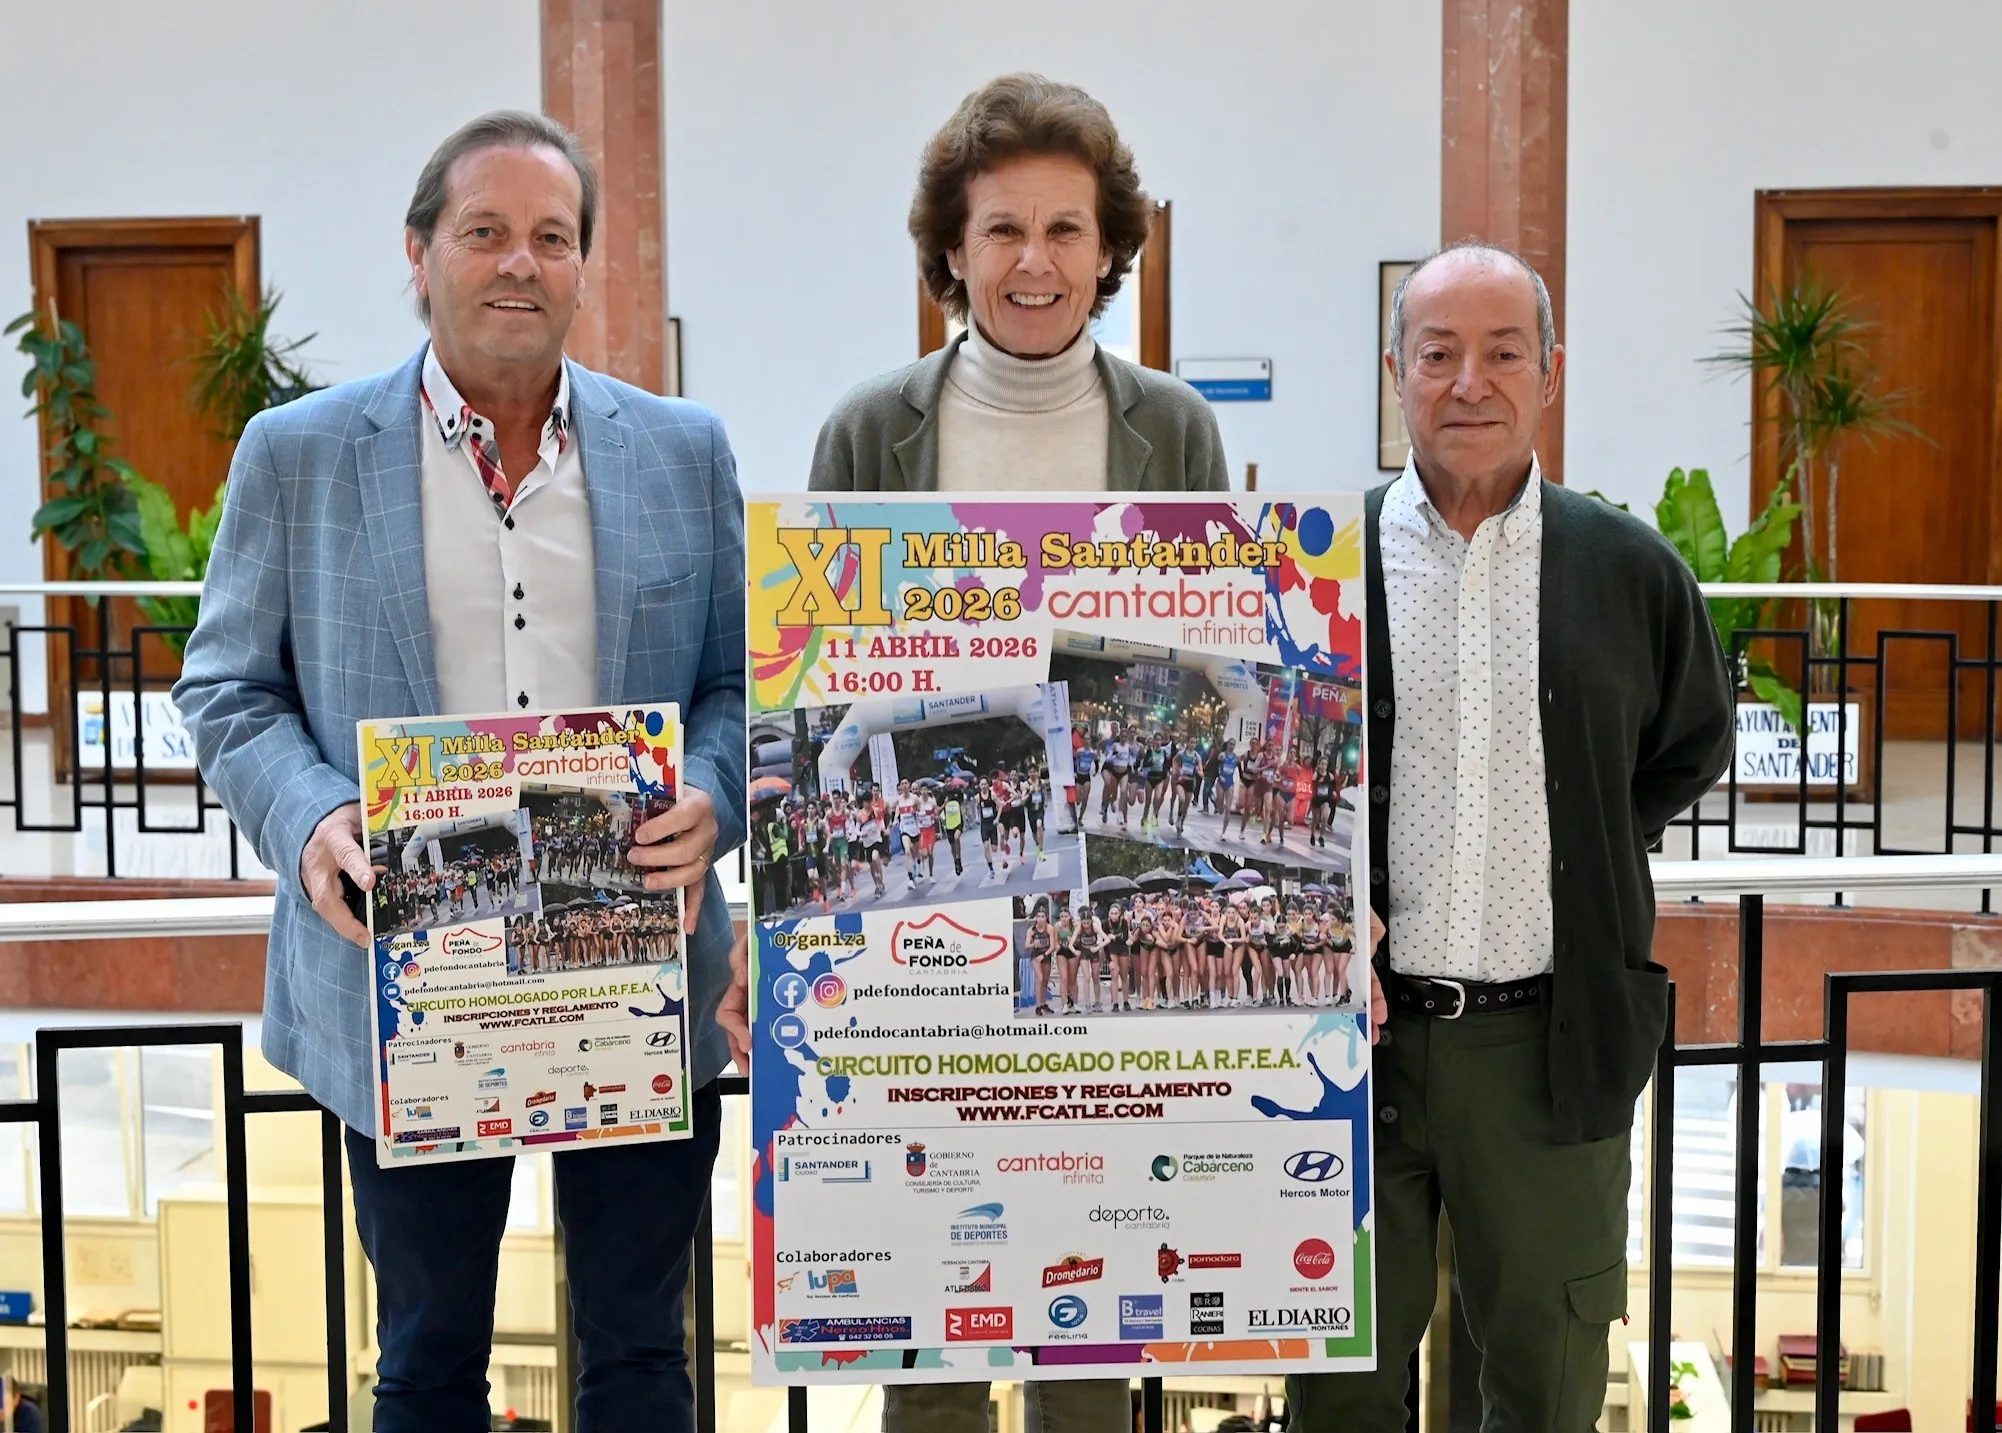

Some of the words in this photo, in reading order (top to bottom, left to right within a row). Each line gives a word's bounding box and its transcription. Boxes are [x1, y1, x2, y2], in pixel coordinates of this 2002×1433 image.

[776, 527, 892, 626] XI
[902, 532, 1028, 568] Milla
[1040, 532, 1287, 568] Santander
[904, 587, 1021, 620] 2026
[1048, 579, 1264, 619] cantabria
[1183, 620, 1265, 644] infinita
[827, 639, 857, 657] 11
[868, 636, 960, 658] ABRIL
[969, 637, 1038, 657] 2026
[827, 671, 903, 692] 16:00
[912, 670, 942, 692] H.
[929, 695, 976, 709] SANTANDER
[1311, 686, 1348, 703] PEÑA
[375, 735, 437, 789] XI
[440, 734, 506, 755] Milla
[512, 726, 640, 751] Santander
[517, 752, 628, 776] cantabria
[443, 761, 504, 782] 2026
[586, 772, 630, 785] infinita
[404, 793, 419, 803] 11
[425, 788, 473, 802] ABRIL
[477, 786, 513, 798] 2026
[404, 808, 444, 821] 16:00
[448, 806, 464, 818] H.
[382, 940, 430, 951] Organiza
[449, 938, 470, 947] PEÑA
[775, 930, 866, 950] Organiza
[903, 936, 945, 950] PEÑA
[950, 940, 962, 953] de
[452, 947, 483, 956] FONDO
[424, 961, 505, 973] pdefondocantabria
[909, 955, 968, 967] FONDO
[404, 976, 545, 996] pdefondocantabria@hotmail.com
[853, 983, 1010, 1000] pdefondocantabria
[406, 999, 466, 1013] CIRCUITO
[469, 990, 559, 1008] HOMOLOGADO
[562, 988, 587, 1000] POR
[590, 987, 606, 997] LA
[609, 982, 654, 996] R.F.E.A.
[443, 1009, 531, 1023] INSCRIPCIONES
[533, 1007, 540, 1015] Y
[541, 1001, 619, 1015] REGLAMENTO
[479, 1014, 585, 1030] WWW.FCATLE.COM
[813, 1023, 1088, 1041] pdefondocantabria@hotmail.com
[388, 1038, 452, 1048] Patrocinadores
[501, 1040, 555, 1053] cantabria
[397, 1052, 430, 1060] SANTANDER
[816, 1053, 932, 1076] CIRCUITO
[938, 1051, 1114, 1075] HOMOLOGADO
[1120, 1050, 1170, 1072] POR
[1176, 1050, 1211, 1071] LA
[1214, 1048, 1301, 1069] R.F.E.A.
[888, 1085, 1058, 1102] INSCRIPCIONES
[1061, 1085, 1078, 1099] Y
[1081, 1082, 1232, 1099] REGLAMENTO
[390, 1095, 449, 1106] Colaboradores
[630, 1111, 644, 1120] EL
[644, 1106, 682, 1118] DIARIO
[957, 1103, 1164, 1121] WWW.FCATLE.COM
[490, 1121, 508, 1130] EMD
[778, 1132, 902, 1146] Patrocinadores
[929, 1151, 973, 1160] GOBIERNO
[997, 1151, 1103, 1172] cantabria
[795, 1160, 858, 1169] SANTANDER
[1182, 1161, 1253, 1173] Cabárceno
[930, 1169, 980, 1178] CANTABRIA
[1063, 1172, 1103, 1184] infinita
[1280, 1189, 1316, 1198] Hercos
[1320, 1188, 1350, 1197] Motor
[951, 1231, 961, 1240] DE
[964, 1230, 1008, 1240] DEPORTES
[776, 1249, 892, 1263] Colaboradores
[1189, 1255, 1240, 1264] pomodoro
[808, 1269, 856, 1293] lupa
[1046, 1265, 1100, 1284] Dromedario
[1122, 1300, 1133, 1316] B
[1136, 1303, 1162, 1316] travel
[1192, 1310, 1224, 1320] RANIERI
[826, 1317, 906, 1326] AMBULANCIAS
[971, 1313, 1006, 1328] EMD
[1248, 1310, 1276, 1326] EL
[1277, 1307, 1350, 1326] DIARIO
